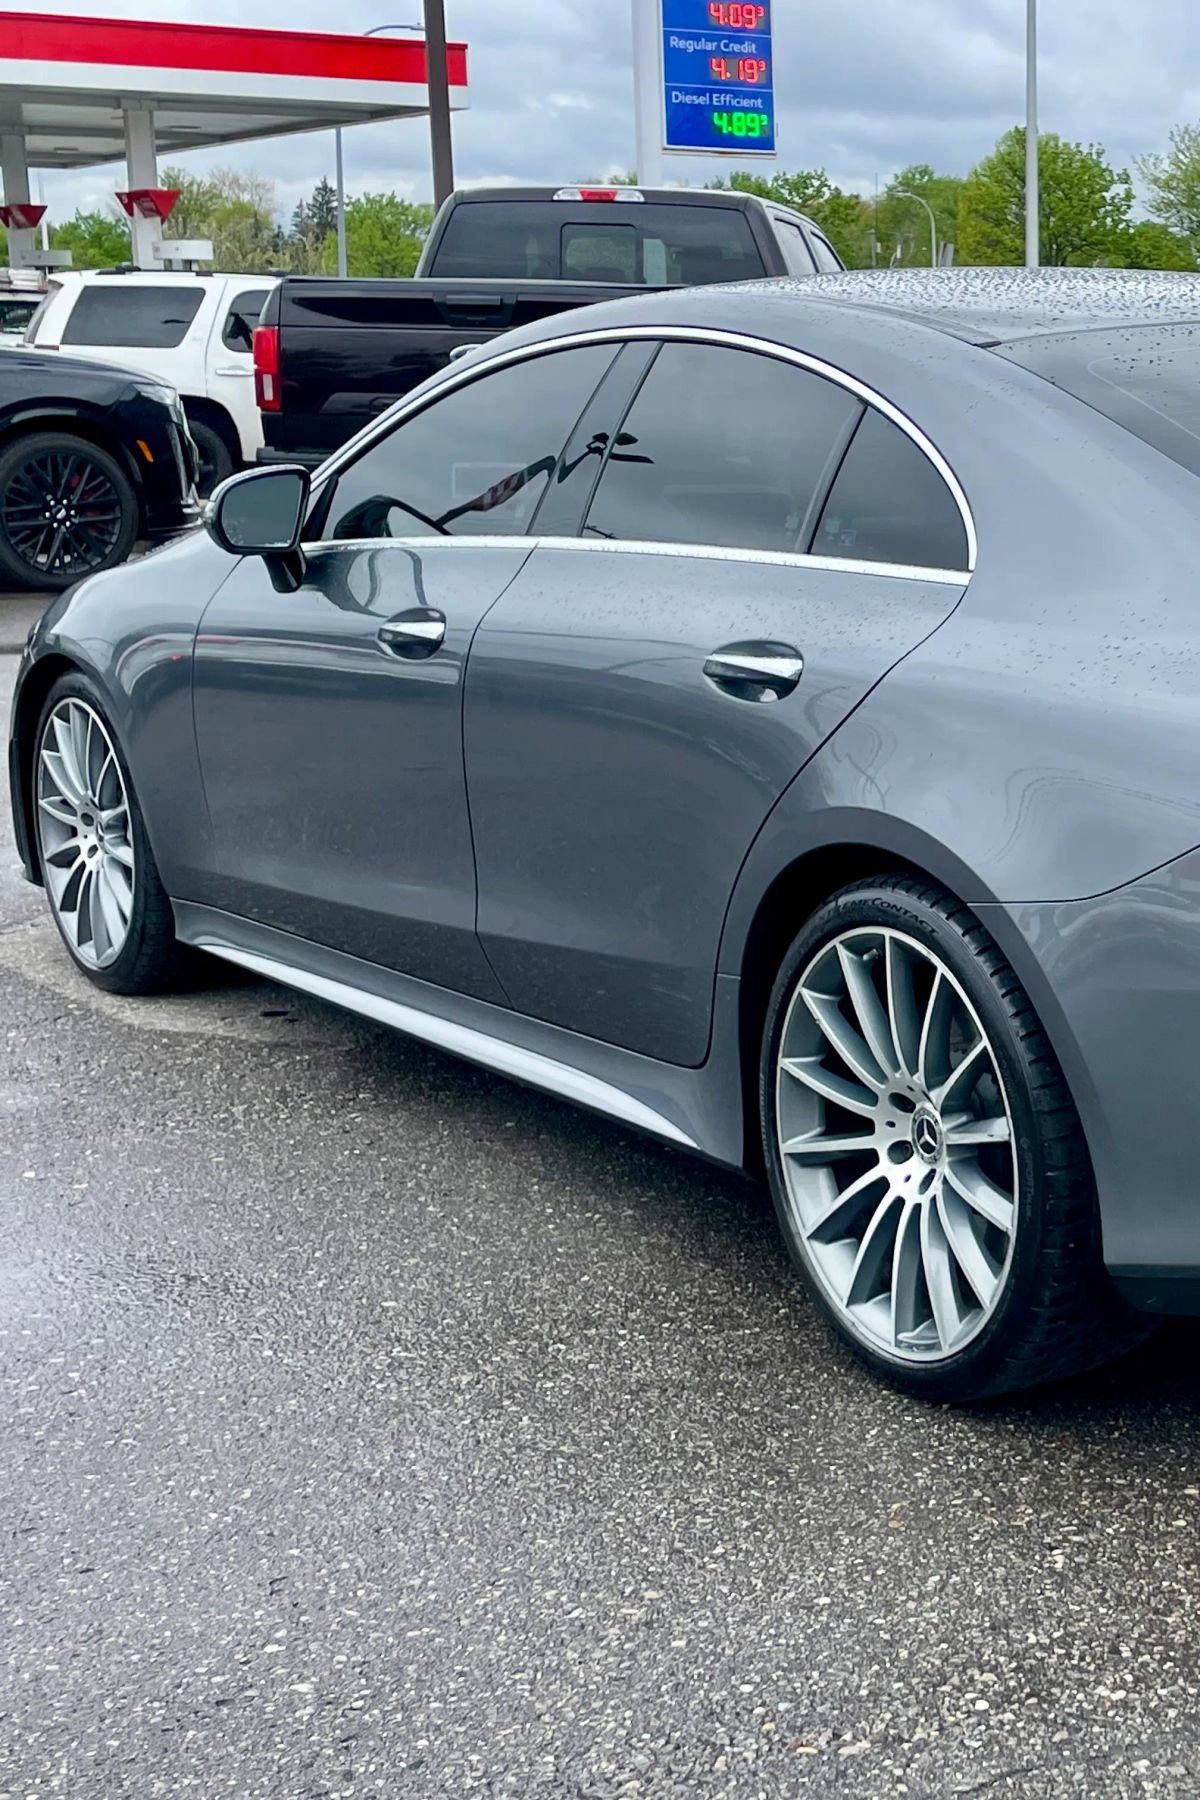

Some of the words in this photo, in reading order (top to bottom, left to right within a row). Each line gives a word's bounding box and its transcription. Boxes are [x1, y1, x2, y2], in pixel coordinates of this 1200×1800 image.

[669, 36, 717, 53] Regular
[720, 40, 757, 54] Credit
[671, 91, 710, 105] Diesel
[712, 93, 763, 109] Efficient
